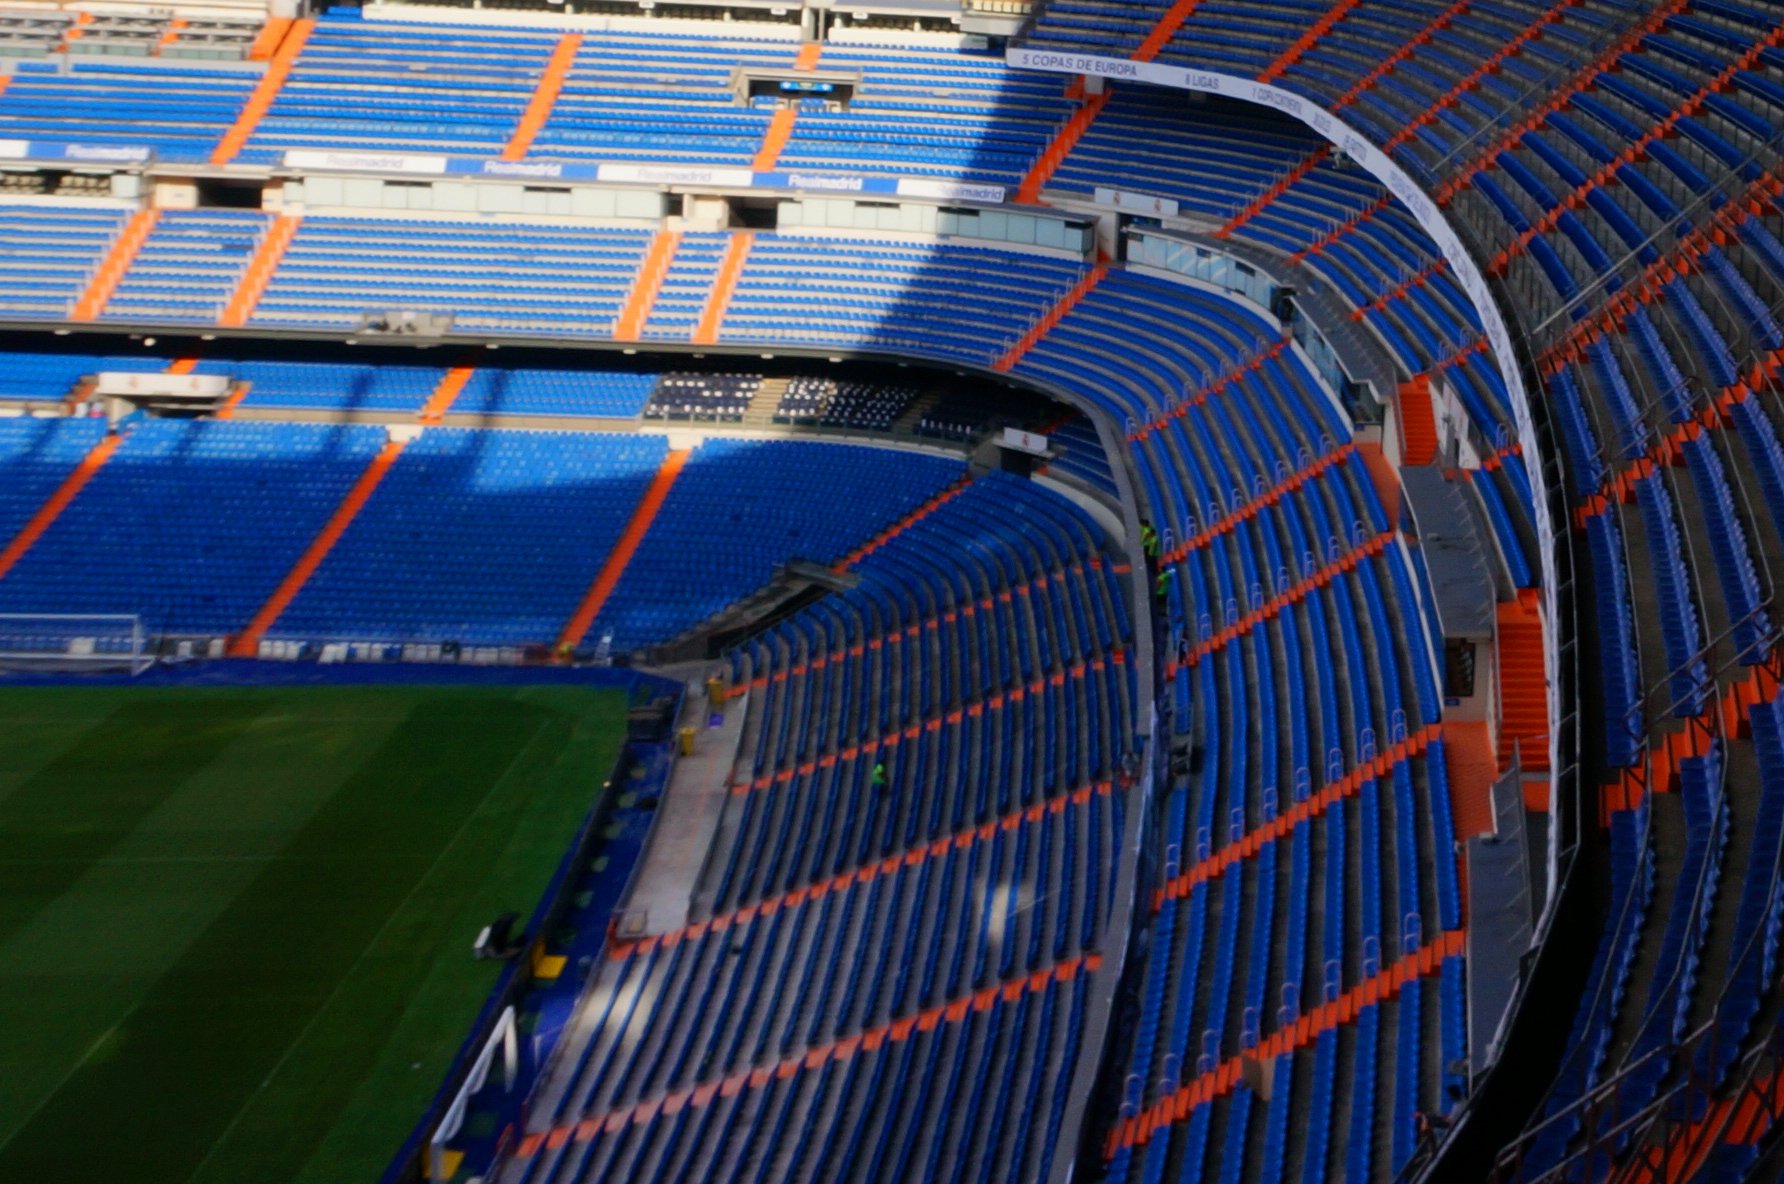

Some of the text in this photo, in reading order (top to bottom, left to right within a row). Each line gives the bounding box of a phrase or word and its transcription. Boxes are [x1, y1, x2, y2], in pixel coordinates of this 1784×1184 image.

[1022, 54, 1029, 65] 5
[1032, 55, 1073, 69] COPAS
[1076, 58, 1093, 70] DE
[1095, 61, 1137, 76] EUROPA
[1191, 74, 1220, 89] LIGAS
[787, 174, 863, 191] Realmadrid
